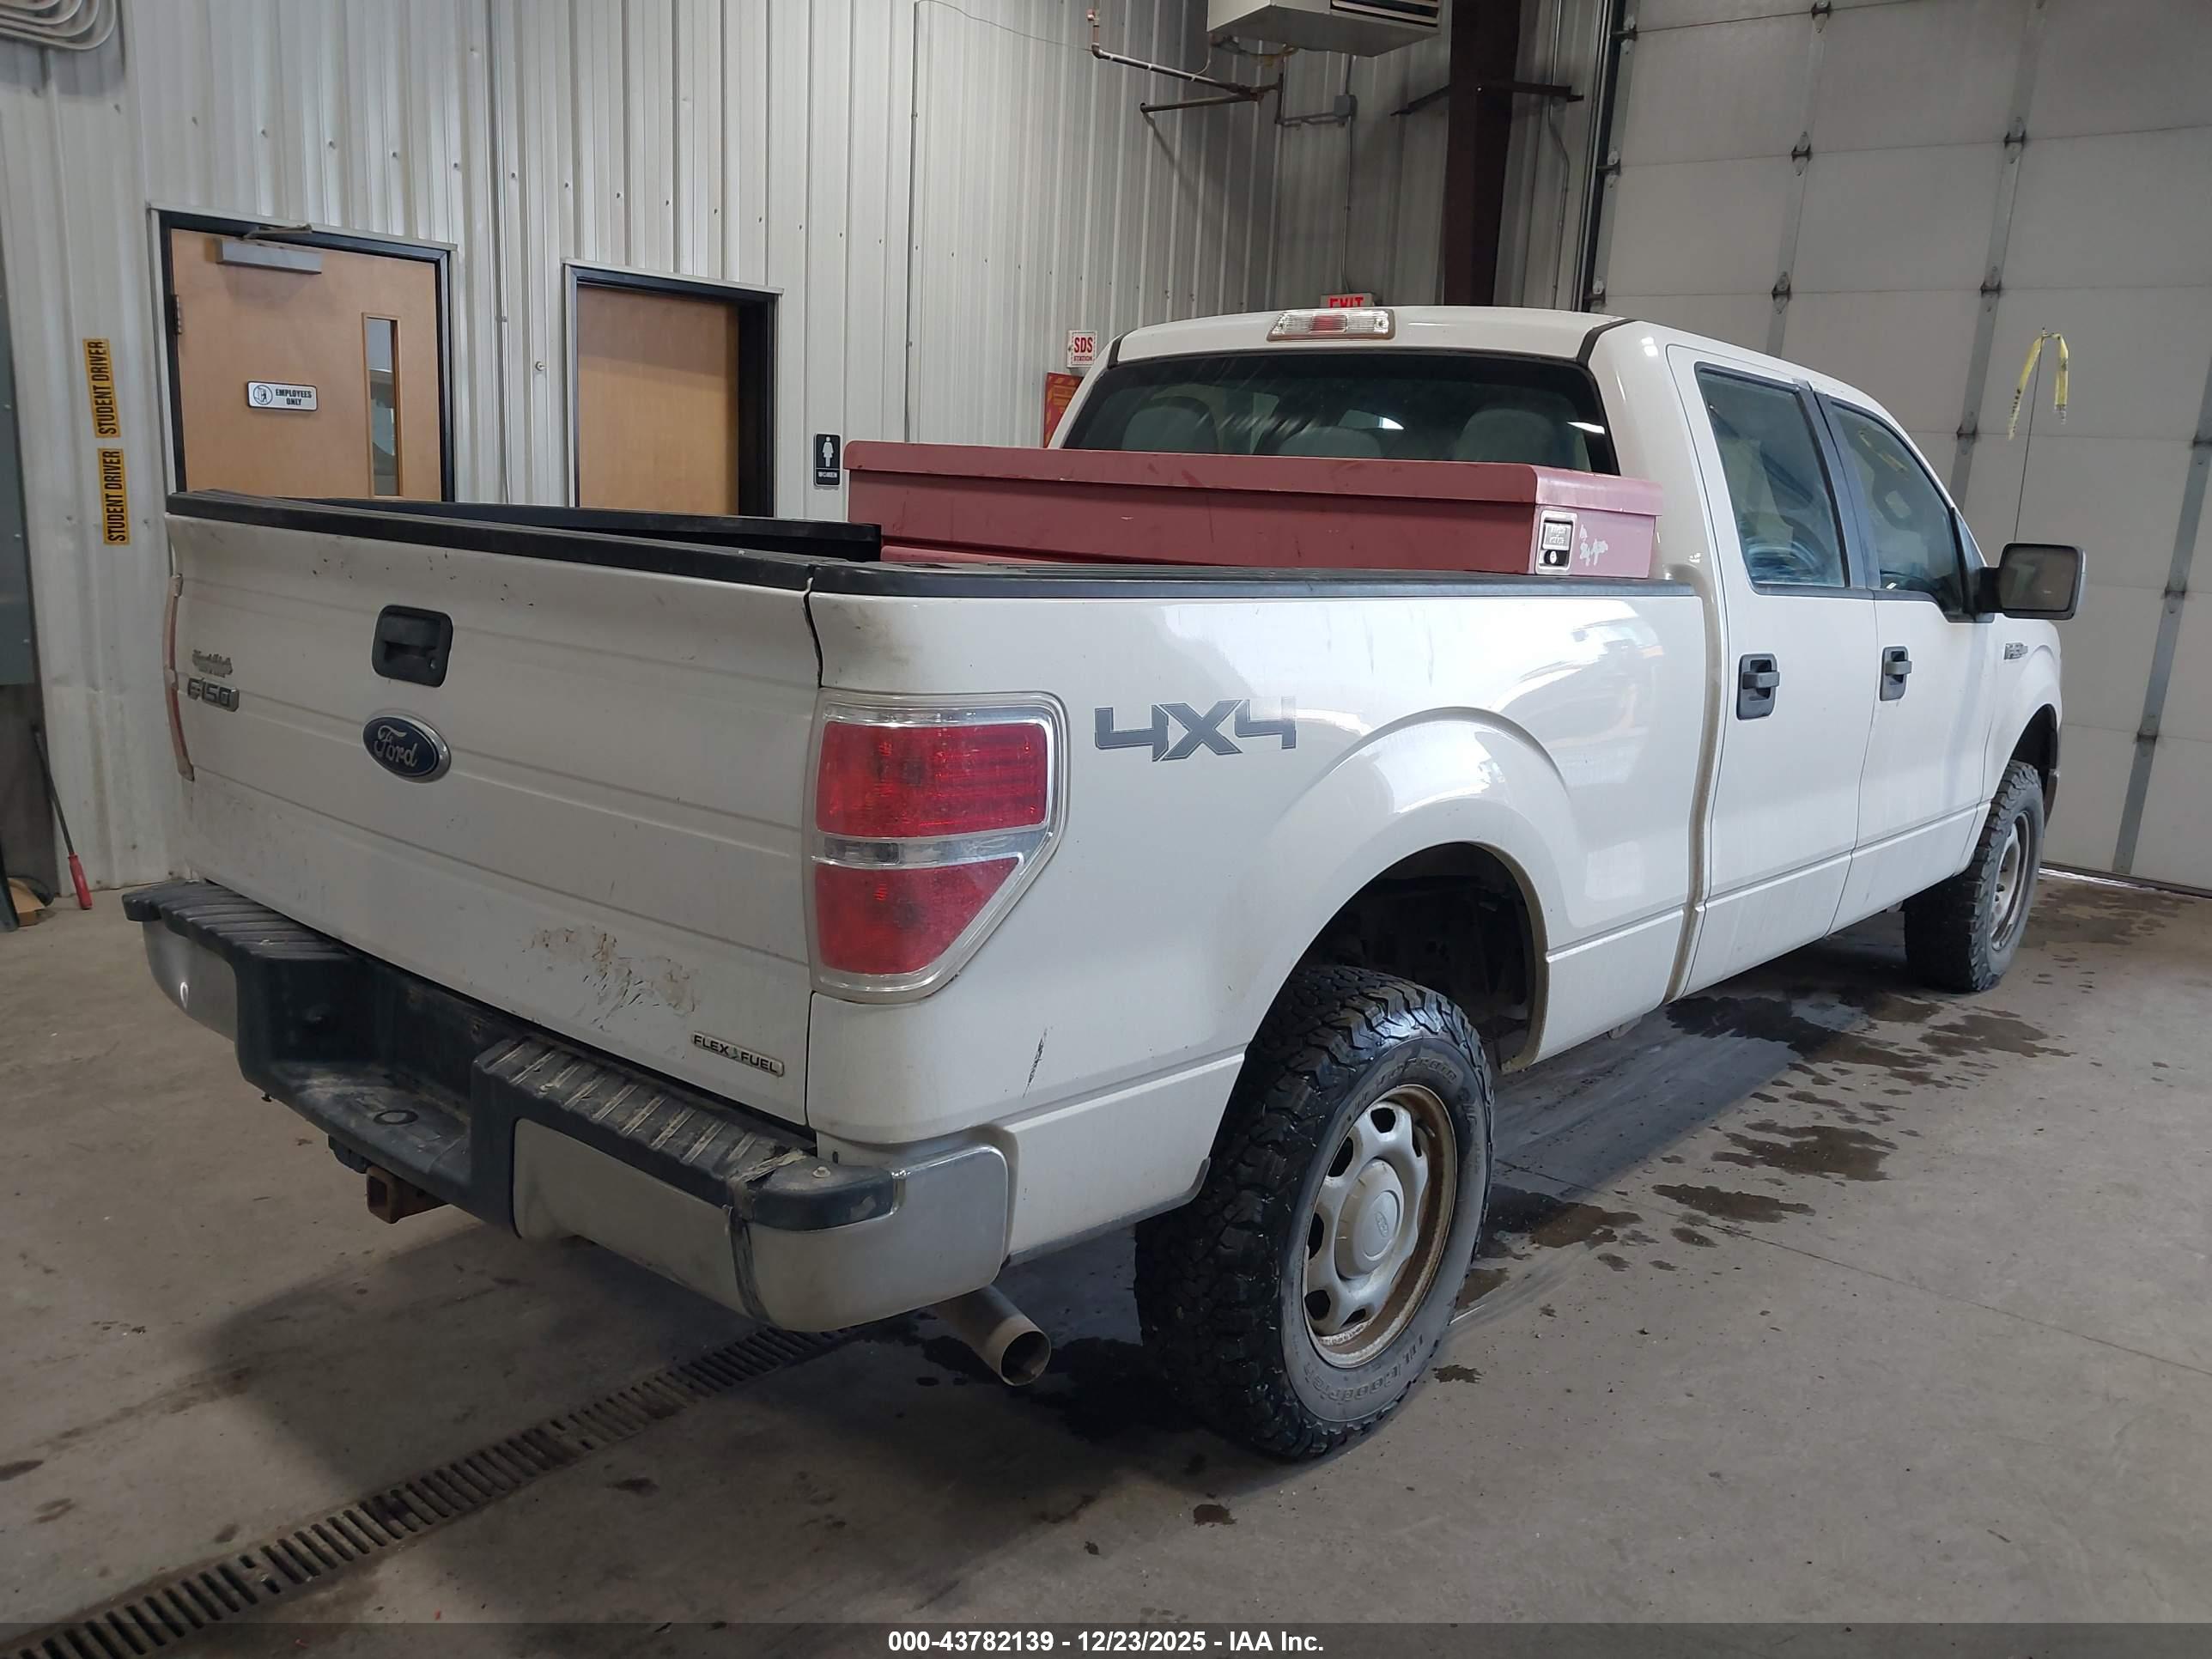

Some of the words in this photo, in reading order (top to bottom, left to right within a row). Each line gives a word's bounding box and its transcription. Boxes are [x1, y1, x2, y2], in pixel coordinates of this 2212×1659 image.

[87, 341, 111, 381] DRIVER
[1073, 337, 1093, 353] SDS
[93, 385, 117, 434] STUDENT
[275, 388, 313, 398] EMPLOYEES
[286, 398, 302, 406] ONLY
[102, 451, 123, 489] DRIVER
[105, 493, 126, 541] STUDENT
[374, 724, 418, 768] Ford
[693, 1034, 730, 1056] FLEX
[740, 1050, 779, 1074] FUEL
